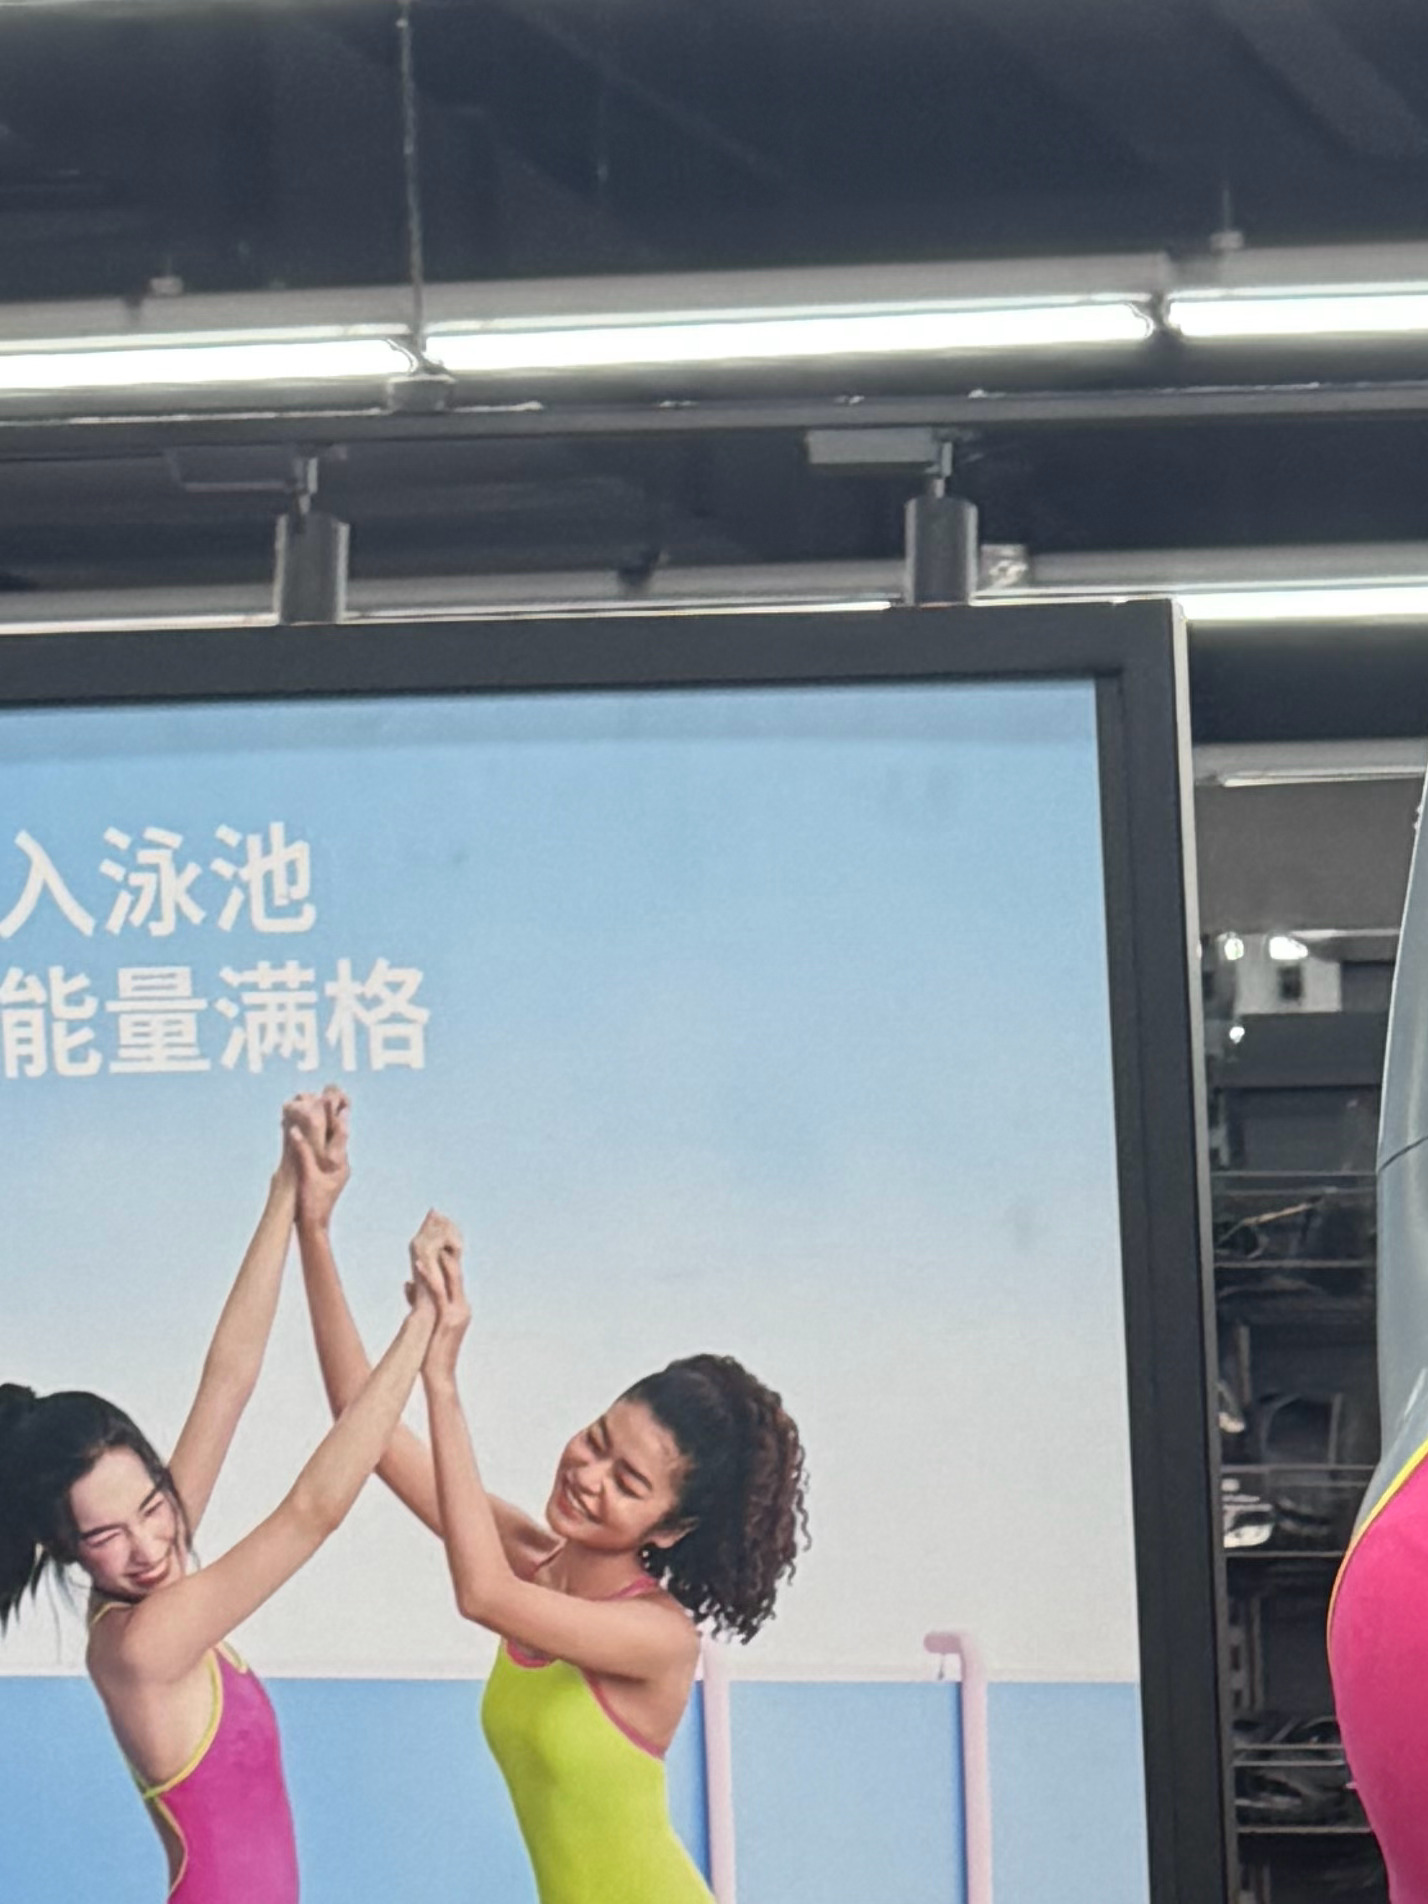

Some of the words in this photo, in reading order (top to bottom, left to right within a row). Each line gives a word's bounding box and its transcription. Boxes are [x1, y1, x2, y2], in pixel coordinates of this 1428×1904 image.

[0, 821, 317, 939] 入泳池
[0, 957, 431, 1079] 能量满格
